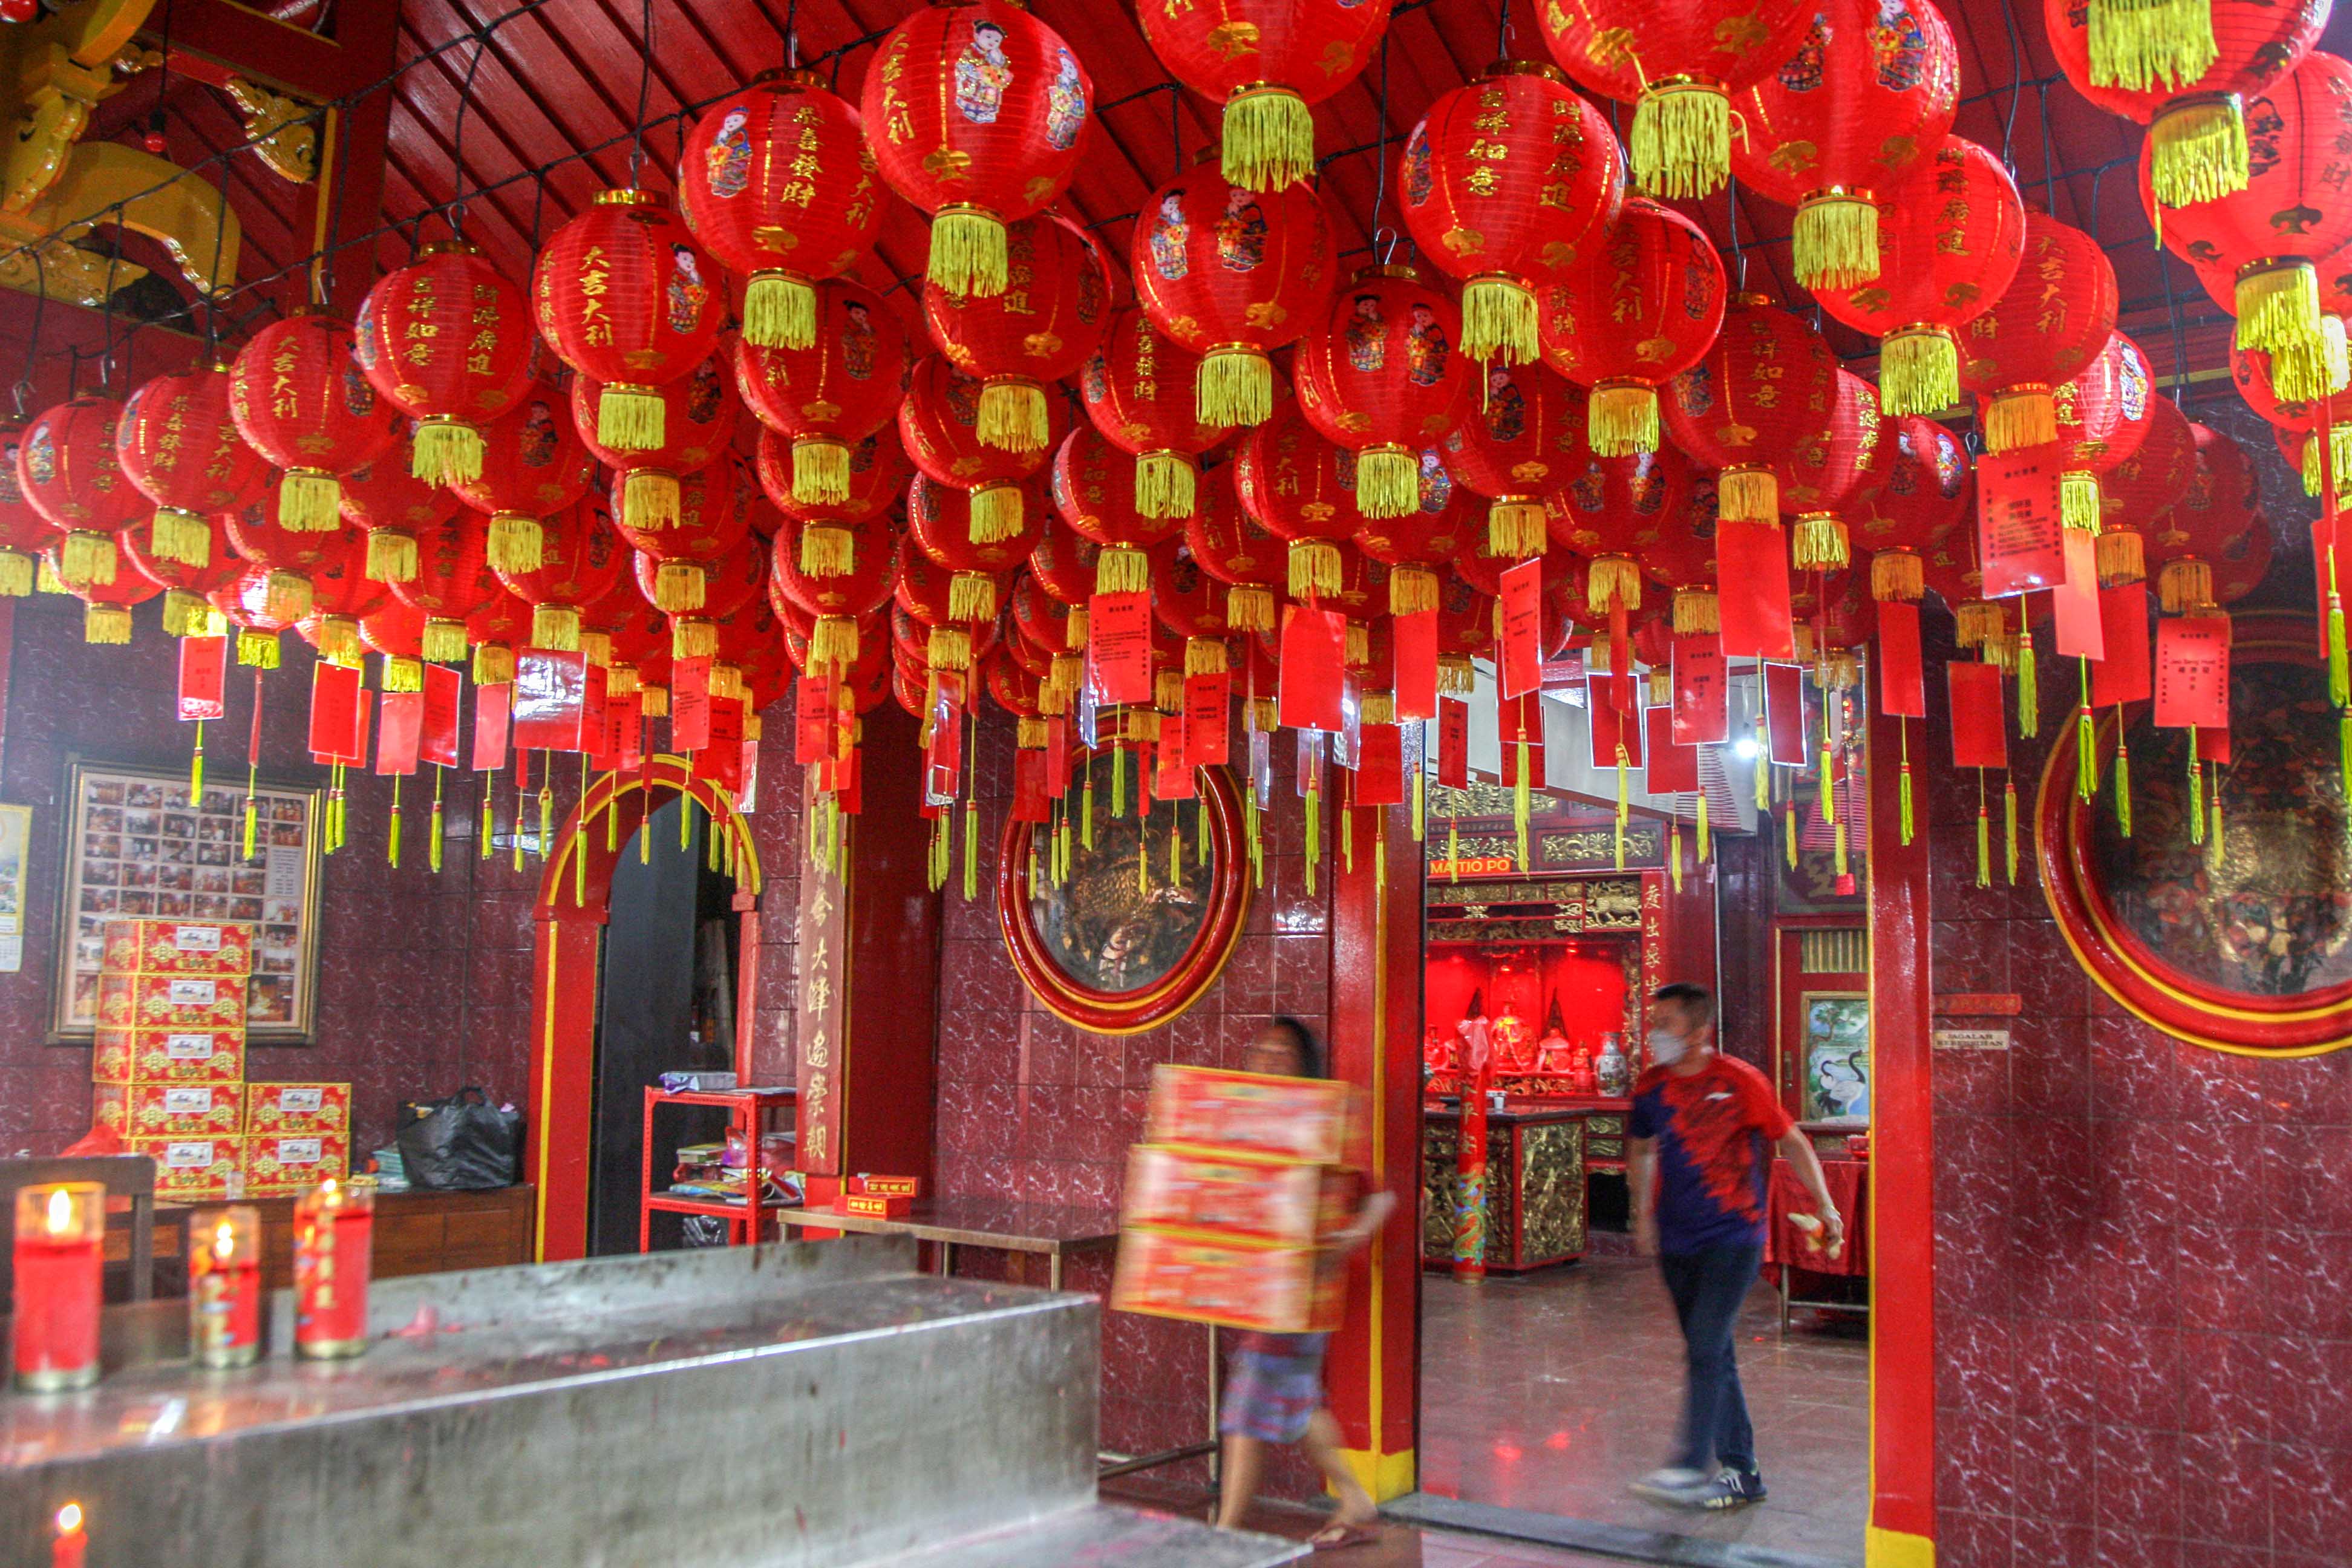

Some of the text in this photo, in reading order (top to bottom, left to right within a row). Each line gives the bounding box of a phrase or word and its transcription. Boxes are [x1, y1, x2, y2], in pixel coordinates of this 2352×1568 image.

[780, 106, 825, 209] 恭喜發財
[1465, 89, 1511, 197] 吉祥如意
[578, 245, 613, 348] 大吉大利
[2036, 235, 2067, 335] 大吉大利
[270, 335, 301, 419] 大吉大利
[1486, 859, 1510, 871] PO
